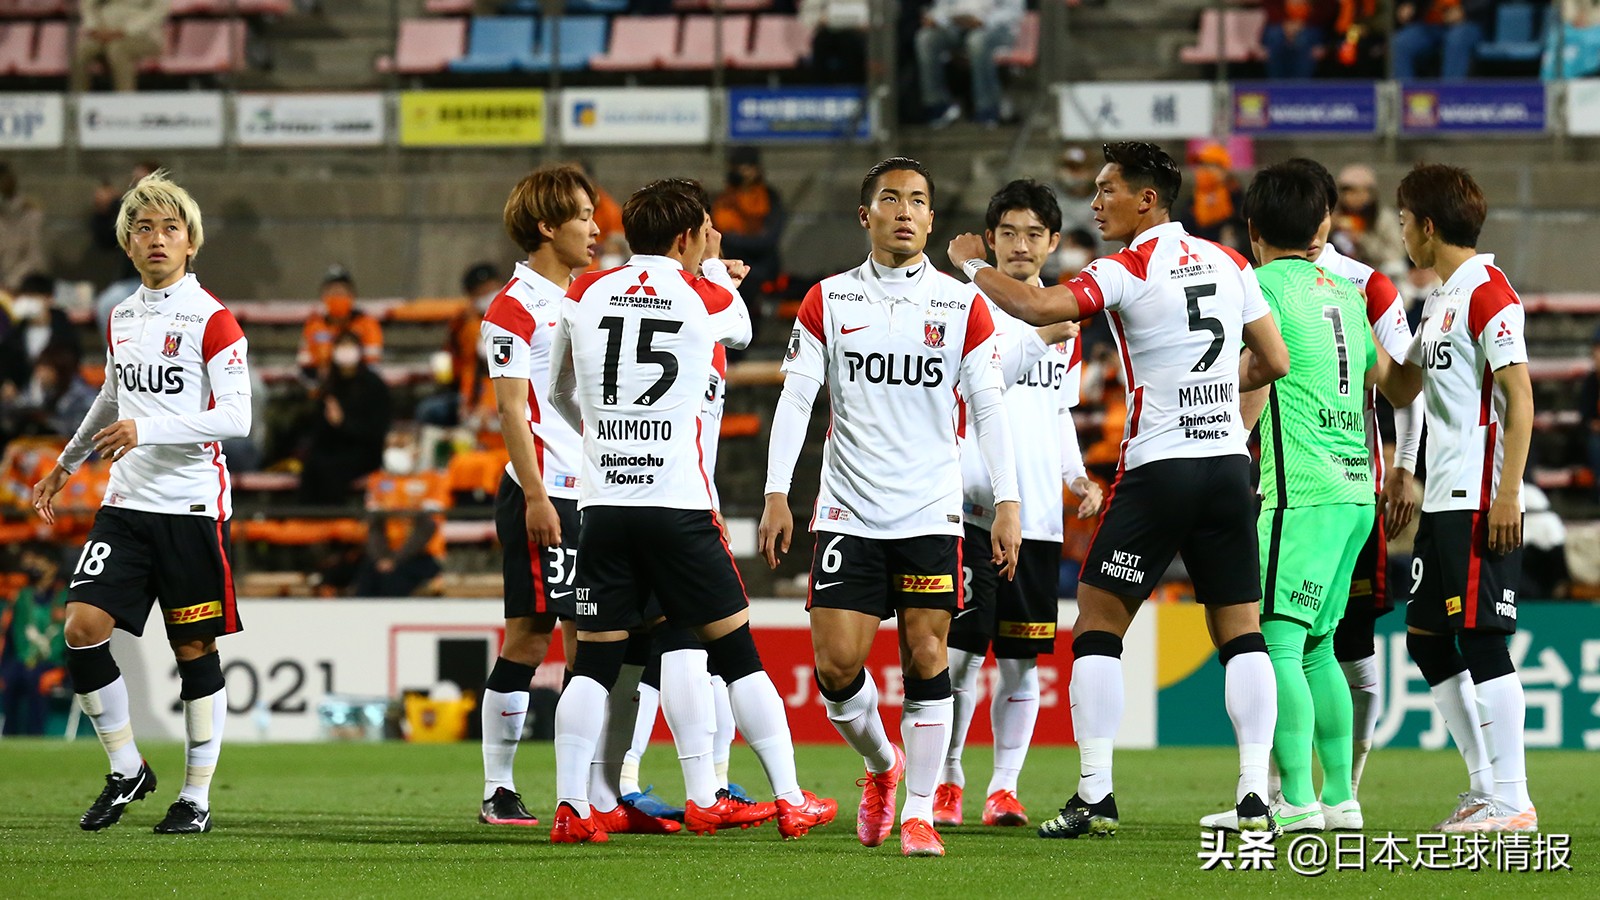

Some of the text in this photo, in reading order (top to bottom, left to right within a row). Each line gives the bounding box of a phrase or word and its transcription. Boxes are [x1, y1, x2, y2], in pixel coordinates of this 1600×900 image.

[610, 295, 672, 306] MITSUBISHI
[828, 292, 864, 302] EneCle
[930, 299, 967, 310] EneCle
[175, 312, 204, 324] EneCle
[1184, 283, 1225, 372] 5
[598, 316, 683, 406] 15
[1323, 305, 1349, 396] 1
[844, 351, 943, 388] POLUS
[1016, 360, 1065, 390] LUS
[1178, 383, 1233, 408] MAKINO
[597, 420, 672, 441] AKIMOTO
[600, 453, 664, 468] Shimachu
[73, 540, 112, 576] 18
[821, 534, 845, 574] 6
[1111, 549, 1142, 568] NEXT
[547, 546, 578, 586] 37
[1100, 560, 1145, 584] PROTEIN
[901, 577, 945, 590] DHL
[1301, 579, 1324, 598] NEXT
[168, 606, 213, 622] DHL
[1008, 624, 1050, 636] DHL
